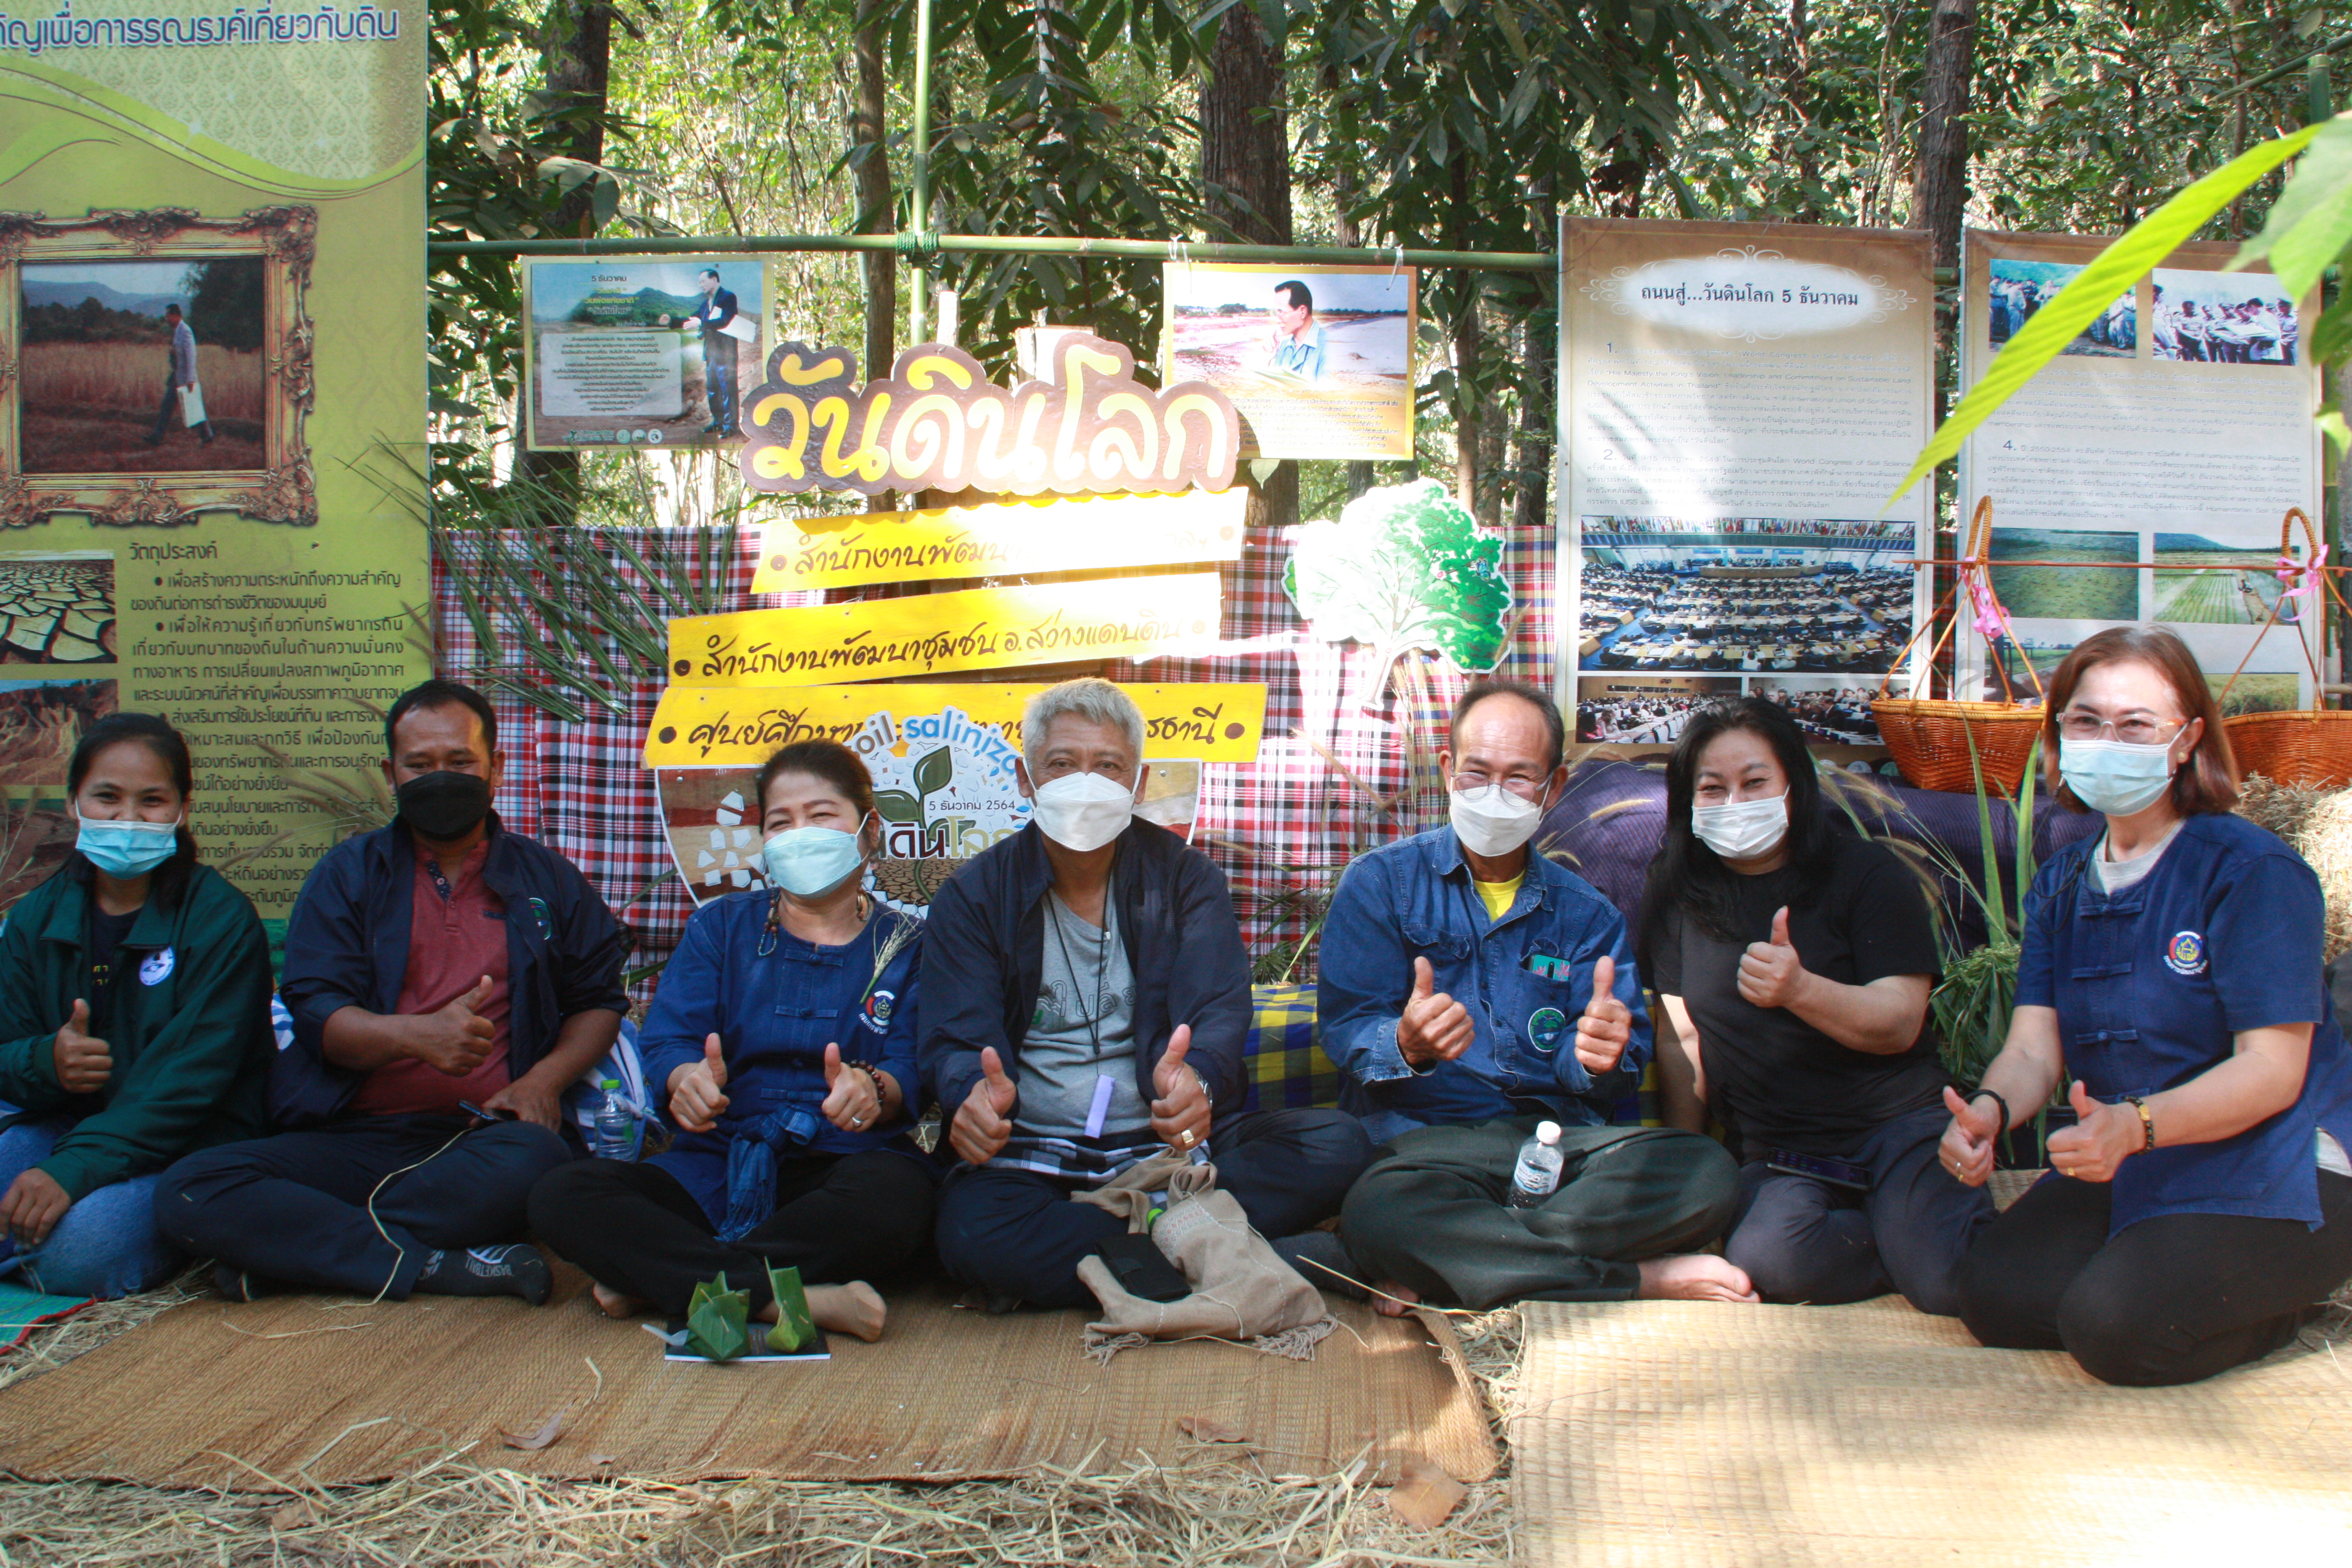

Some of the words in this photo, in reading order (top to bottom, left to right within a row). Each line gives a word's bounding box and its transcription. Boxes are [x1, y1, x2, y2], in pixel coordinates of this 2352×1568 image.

[1782, 289, 1792, 303] 5
[1799, 286, 1858, 305] ธันวาคม
[752, 345, 1226, 481] วันดินโลก
[134, 668, 198, 678] ทางอาหาร
[857, 715, 894, 754] oil
[929, 801, 936, 810] 5
[940, 800, 982, 810] ธันวาคม
[987, 800, 1015, 810] 2564
